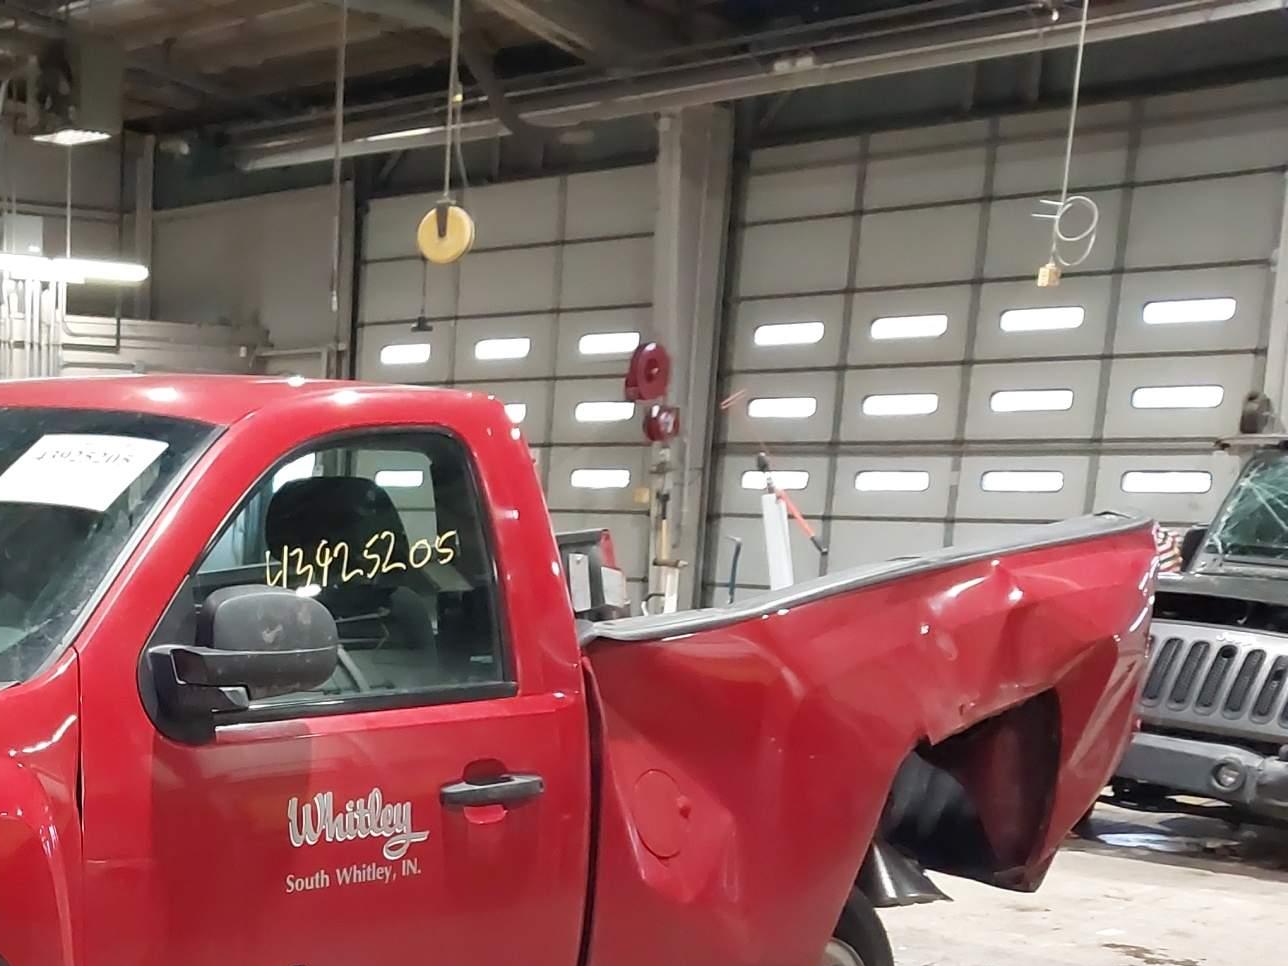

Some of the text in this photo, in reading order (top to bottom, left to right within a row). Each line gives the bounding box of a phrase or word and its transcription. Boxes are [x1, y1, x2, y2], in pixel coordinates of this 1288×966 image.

[265, 530, 457, 588] 43925205
[287, 787, 430, 860] Whitley
[286, 857, 422, 893] South Whitley, IN.
